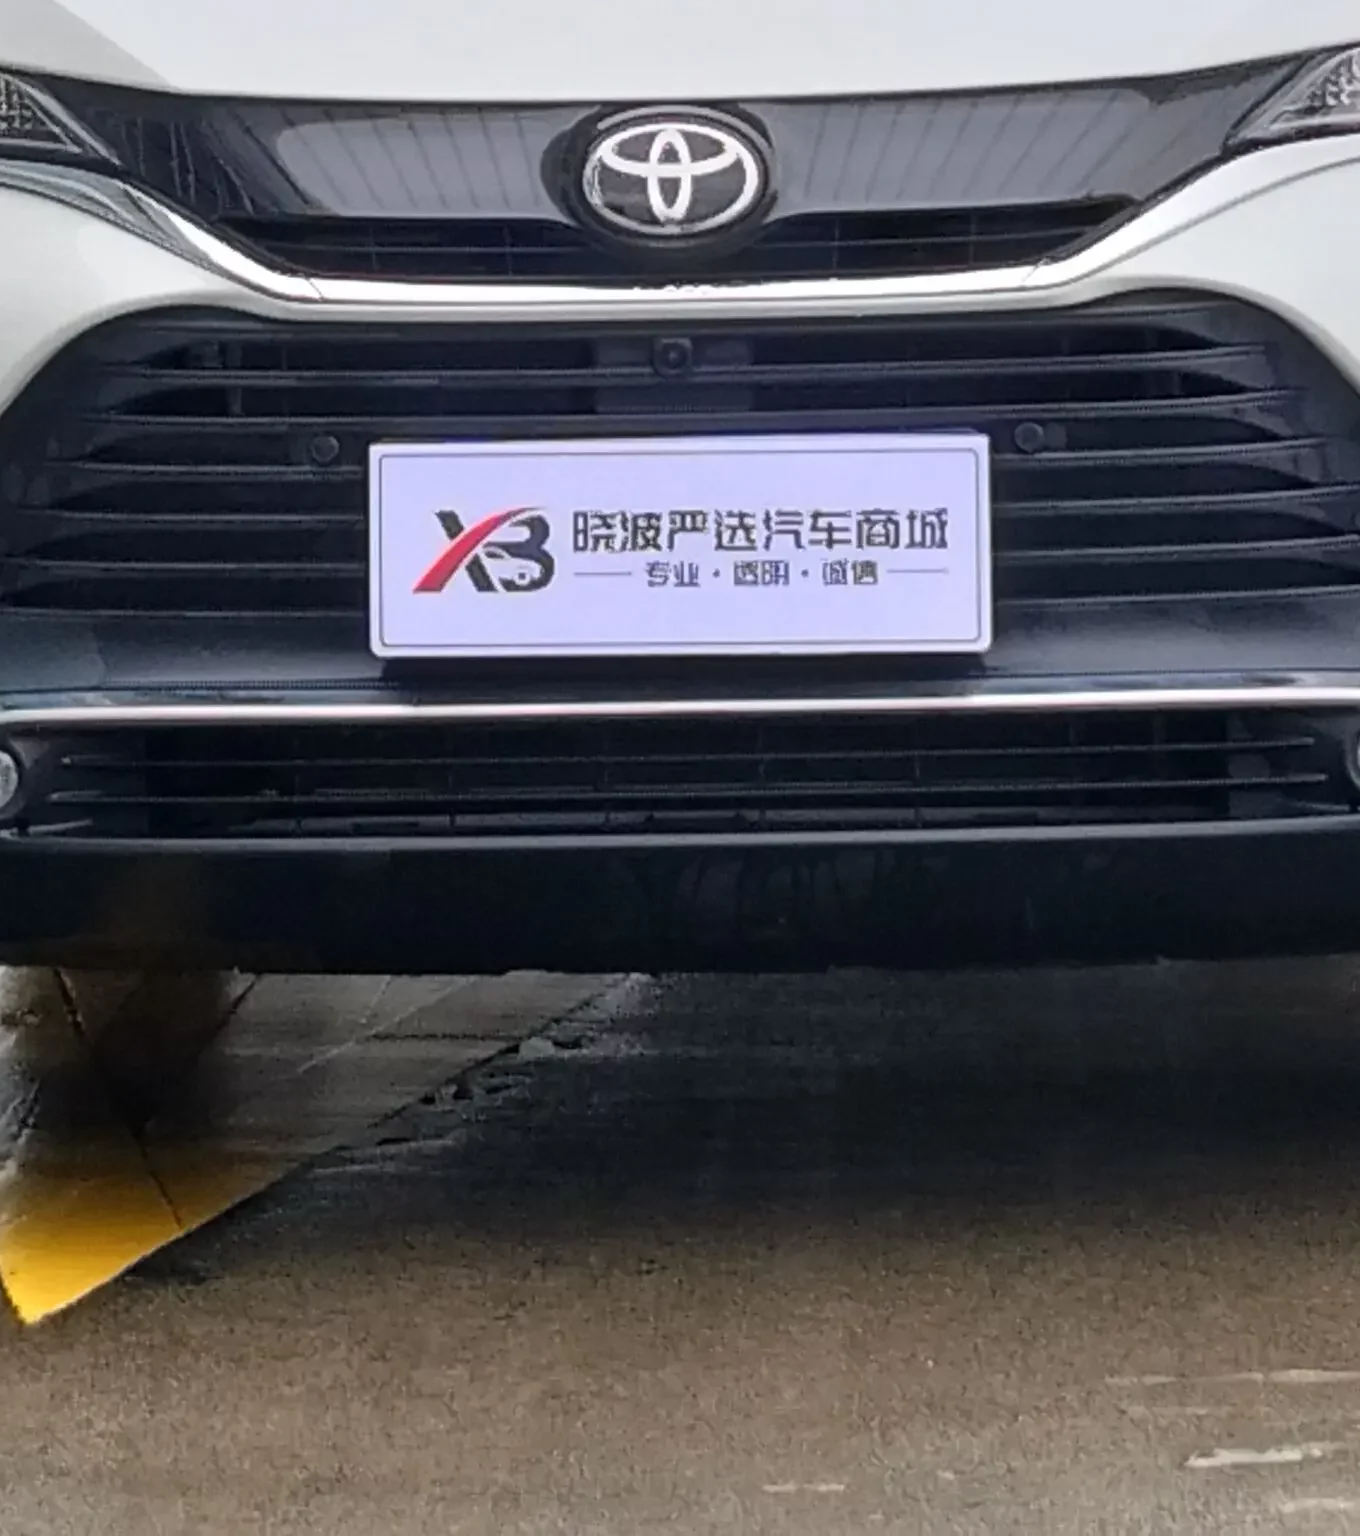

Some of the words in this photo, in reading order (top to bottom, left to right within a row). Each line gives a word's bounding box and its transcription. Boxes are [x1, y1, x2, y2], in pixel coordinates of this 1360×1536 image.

[572, 507, 950, 553] 晓波严选汽车商城
